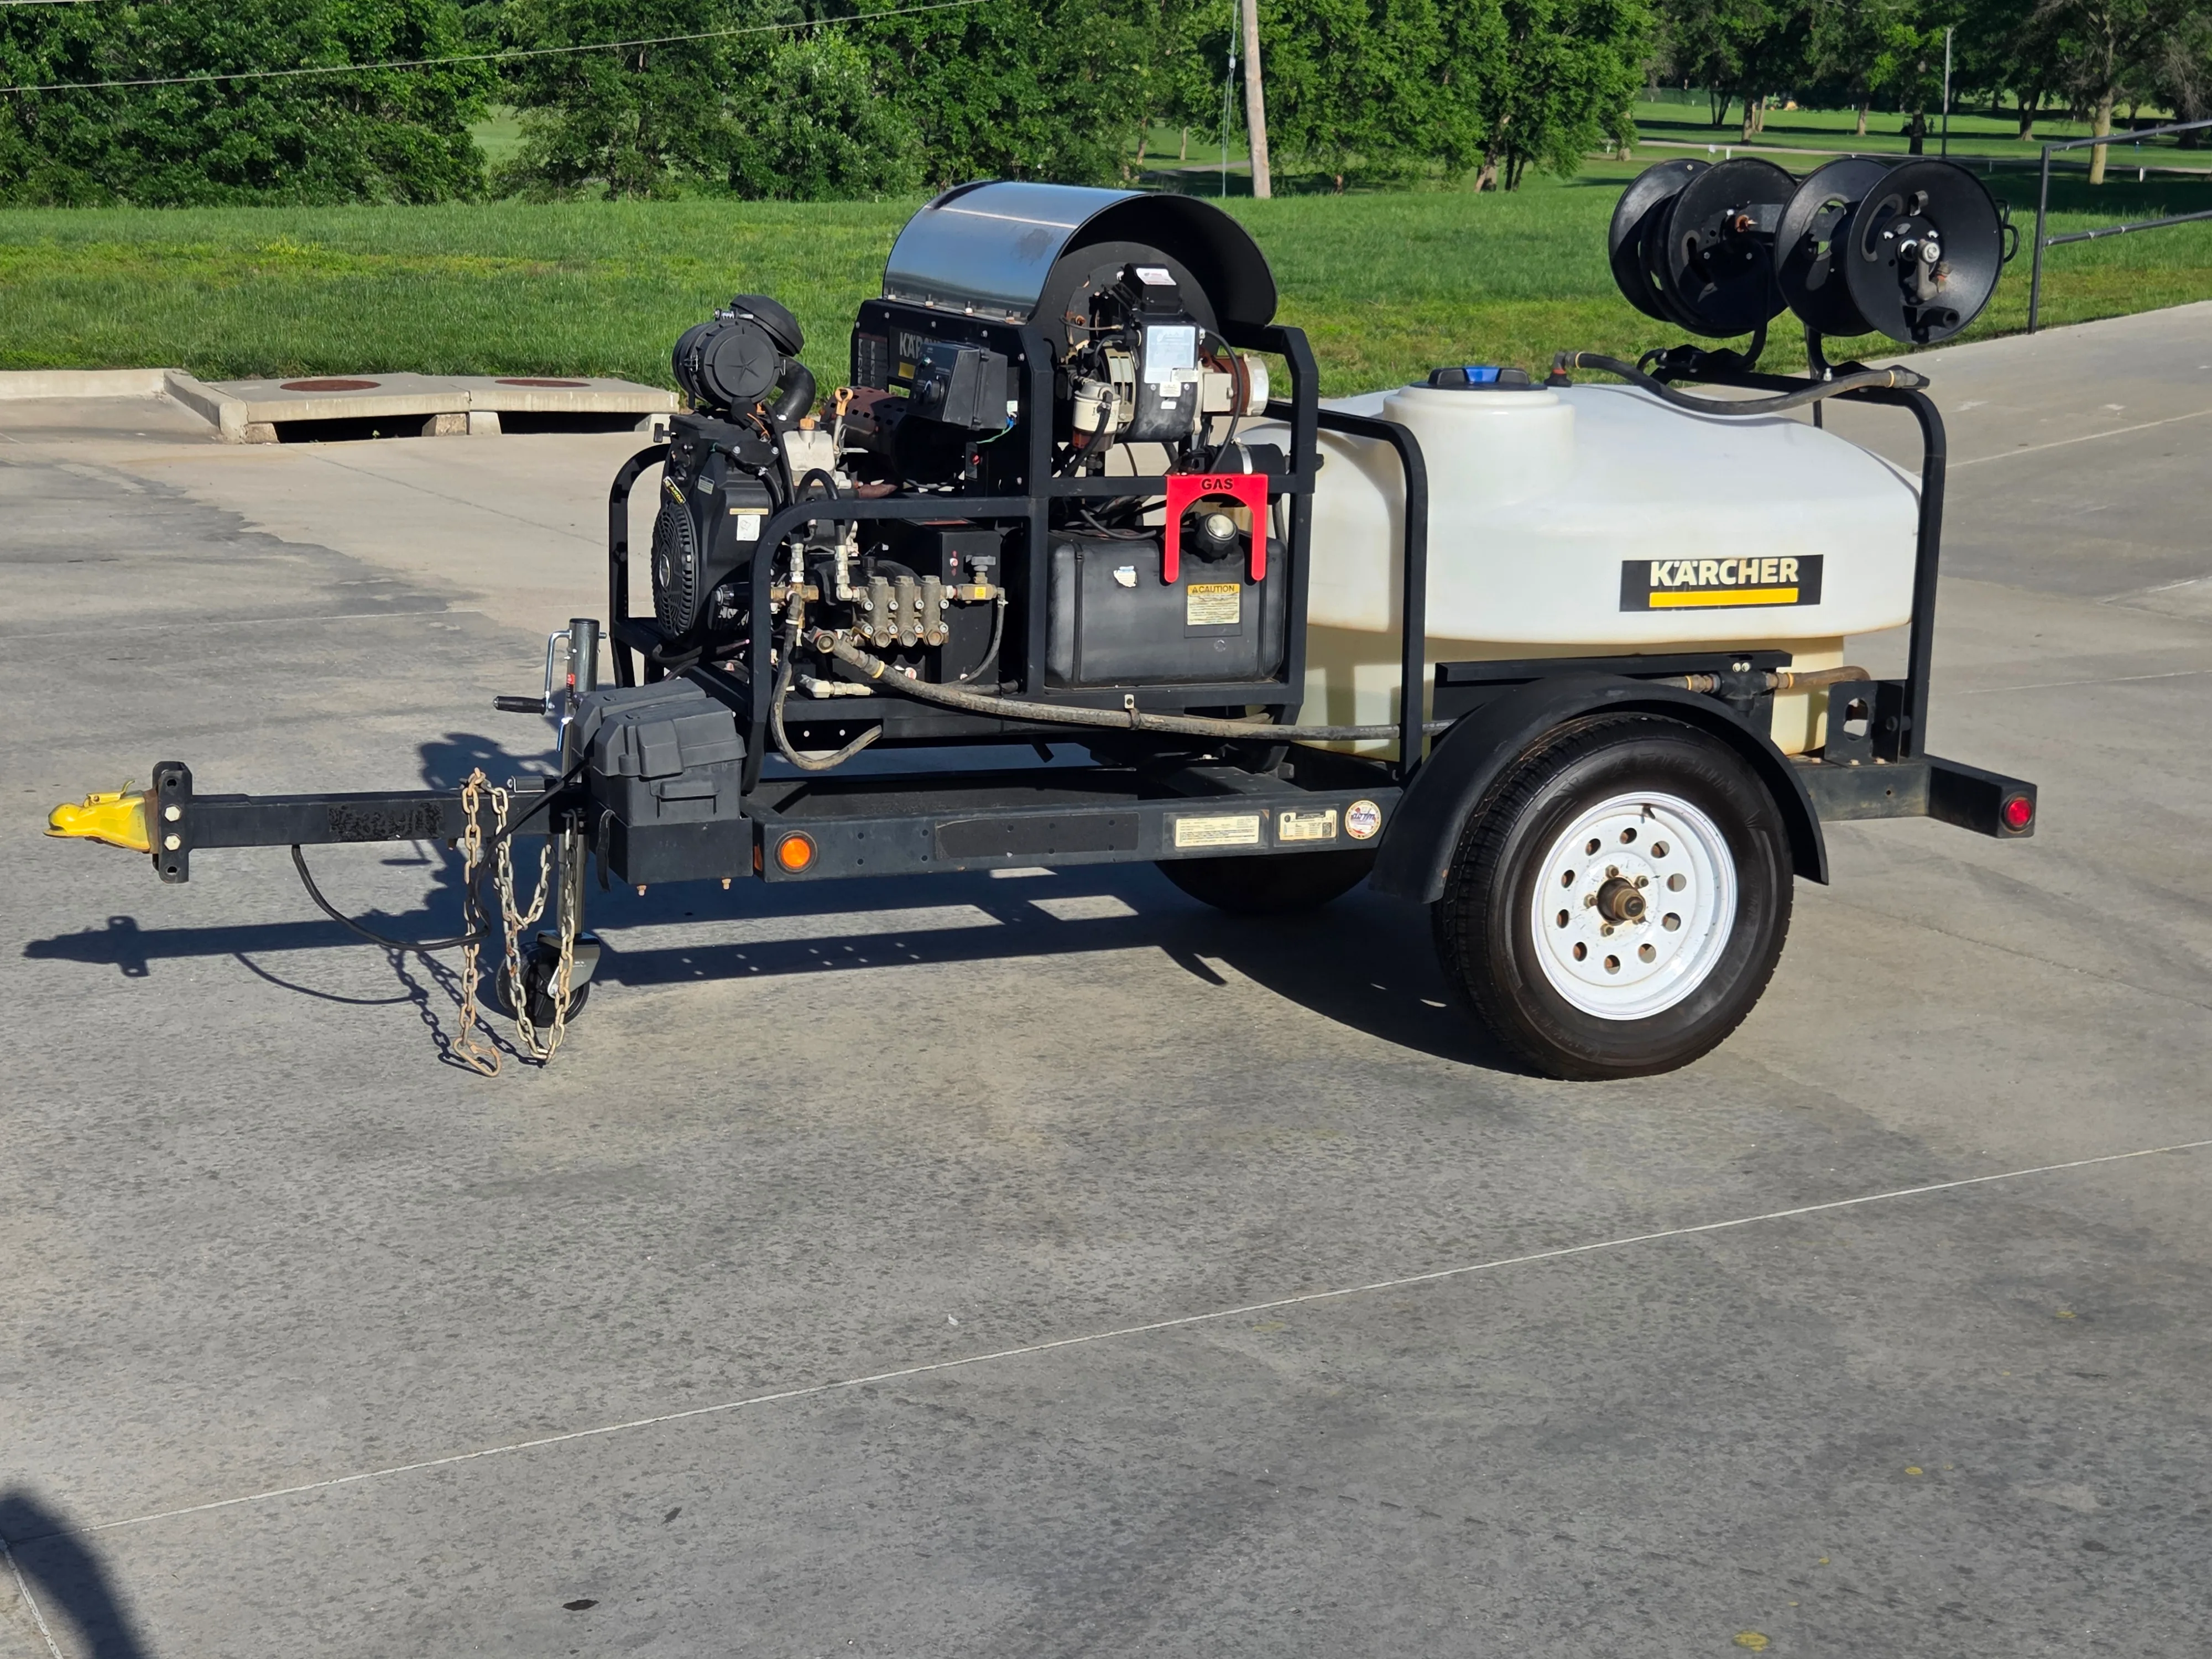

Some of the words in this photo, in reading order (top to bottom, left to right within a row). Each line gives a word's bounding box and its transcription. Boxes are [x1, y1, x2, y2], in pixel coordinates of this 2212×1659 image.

[1202, 478, 1233, 490] GAS
[1650, 557, 1799, 587] KÄRCHER
[1199, 585, 1235, 593] CAUTION
